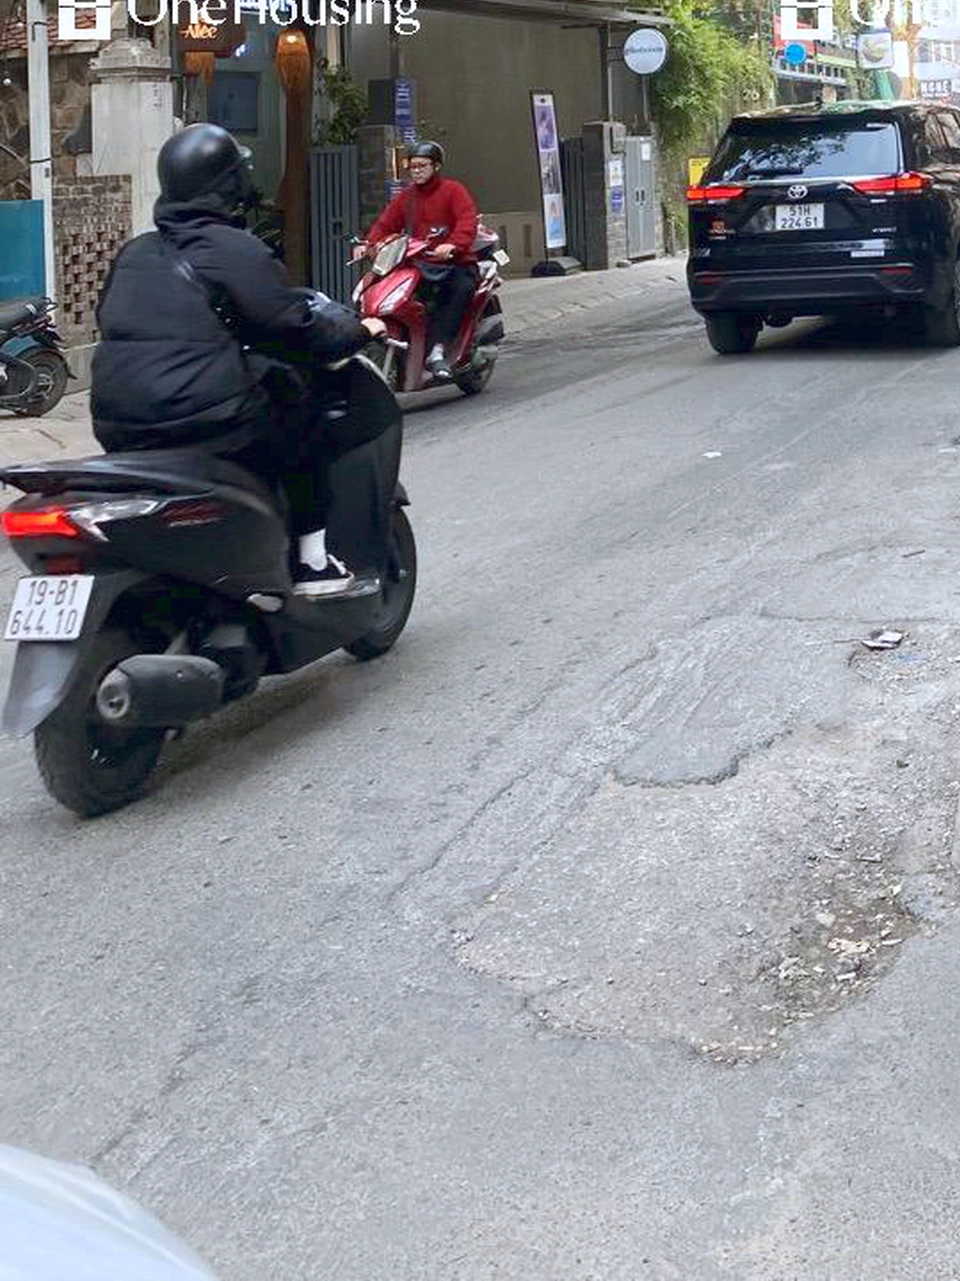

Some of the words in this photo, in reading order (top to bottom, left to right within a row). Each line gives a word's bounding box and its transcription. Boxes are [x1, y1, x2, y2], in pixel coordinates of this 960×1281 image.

[789, 204, 810, 217] 51H
[28, 579, 79, 607] 19-B1
[9, 609, 79, 636] 644.10
